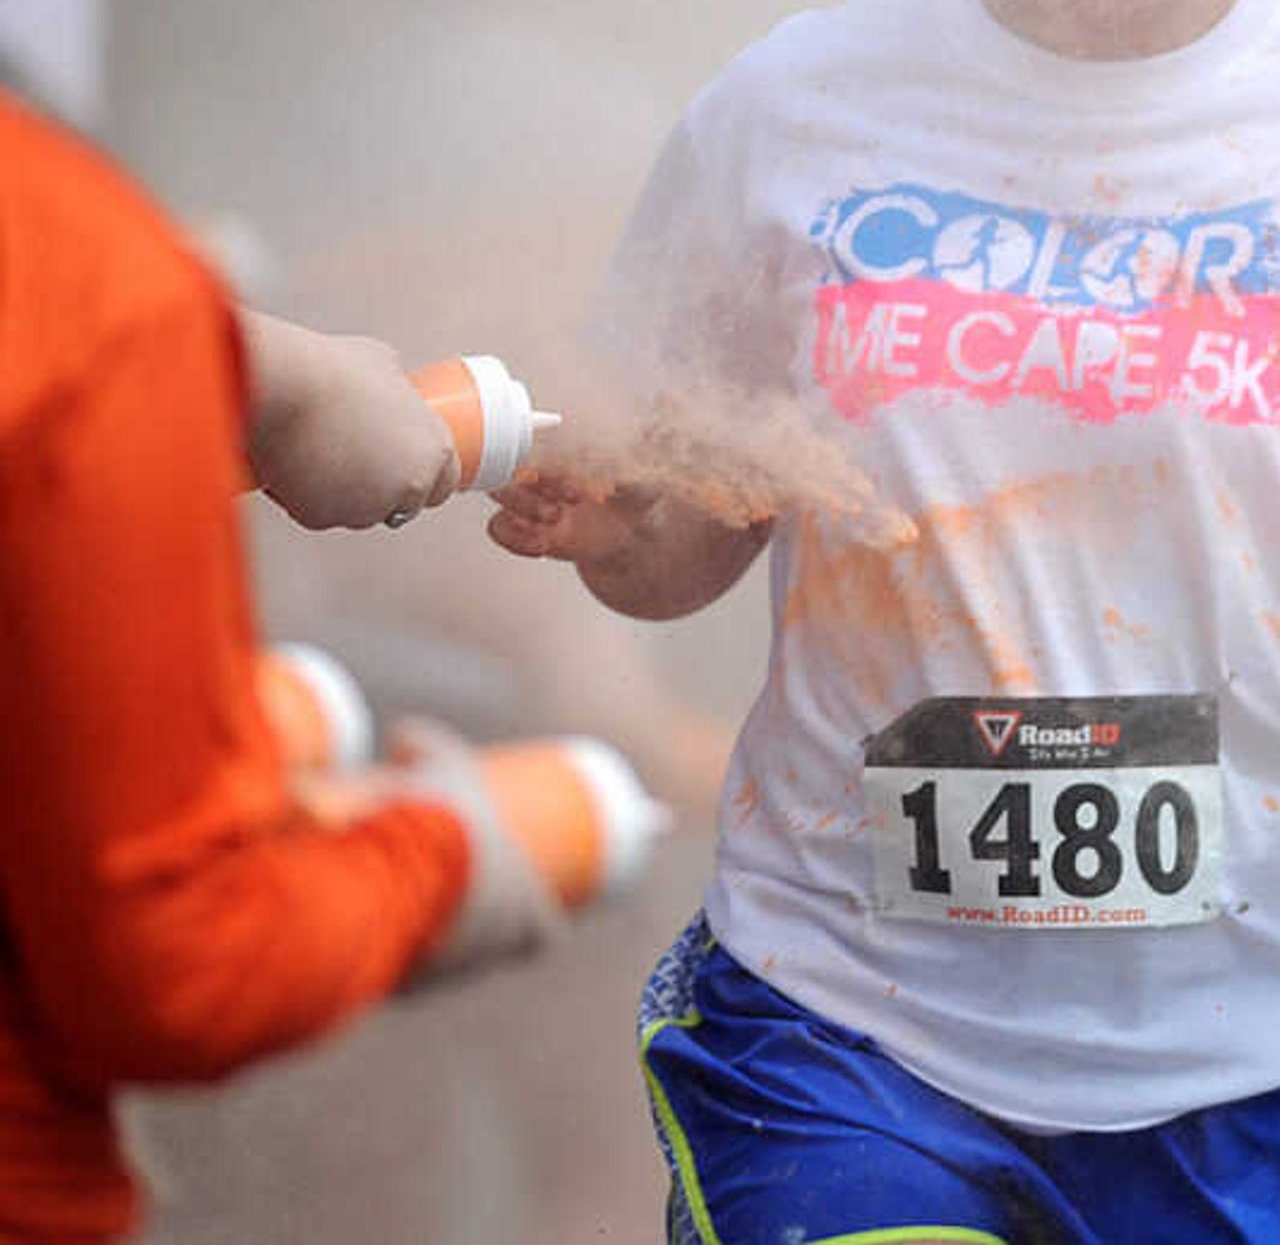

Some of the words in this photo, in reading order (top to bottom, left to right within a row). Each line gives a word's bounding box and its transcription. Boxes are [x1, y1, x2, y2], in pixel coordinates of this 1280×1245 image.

[834, 193, 1254, 316] COLOR
[823, 301, 927, 378] ME
[902, 780, 1200, 899] 1480
[946, 904, 1147, 924] www.RoadID.com
